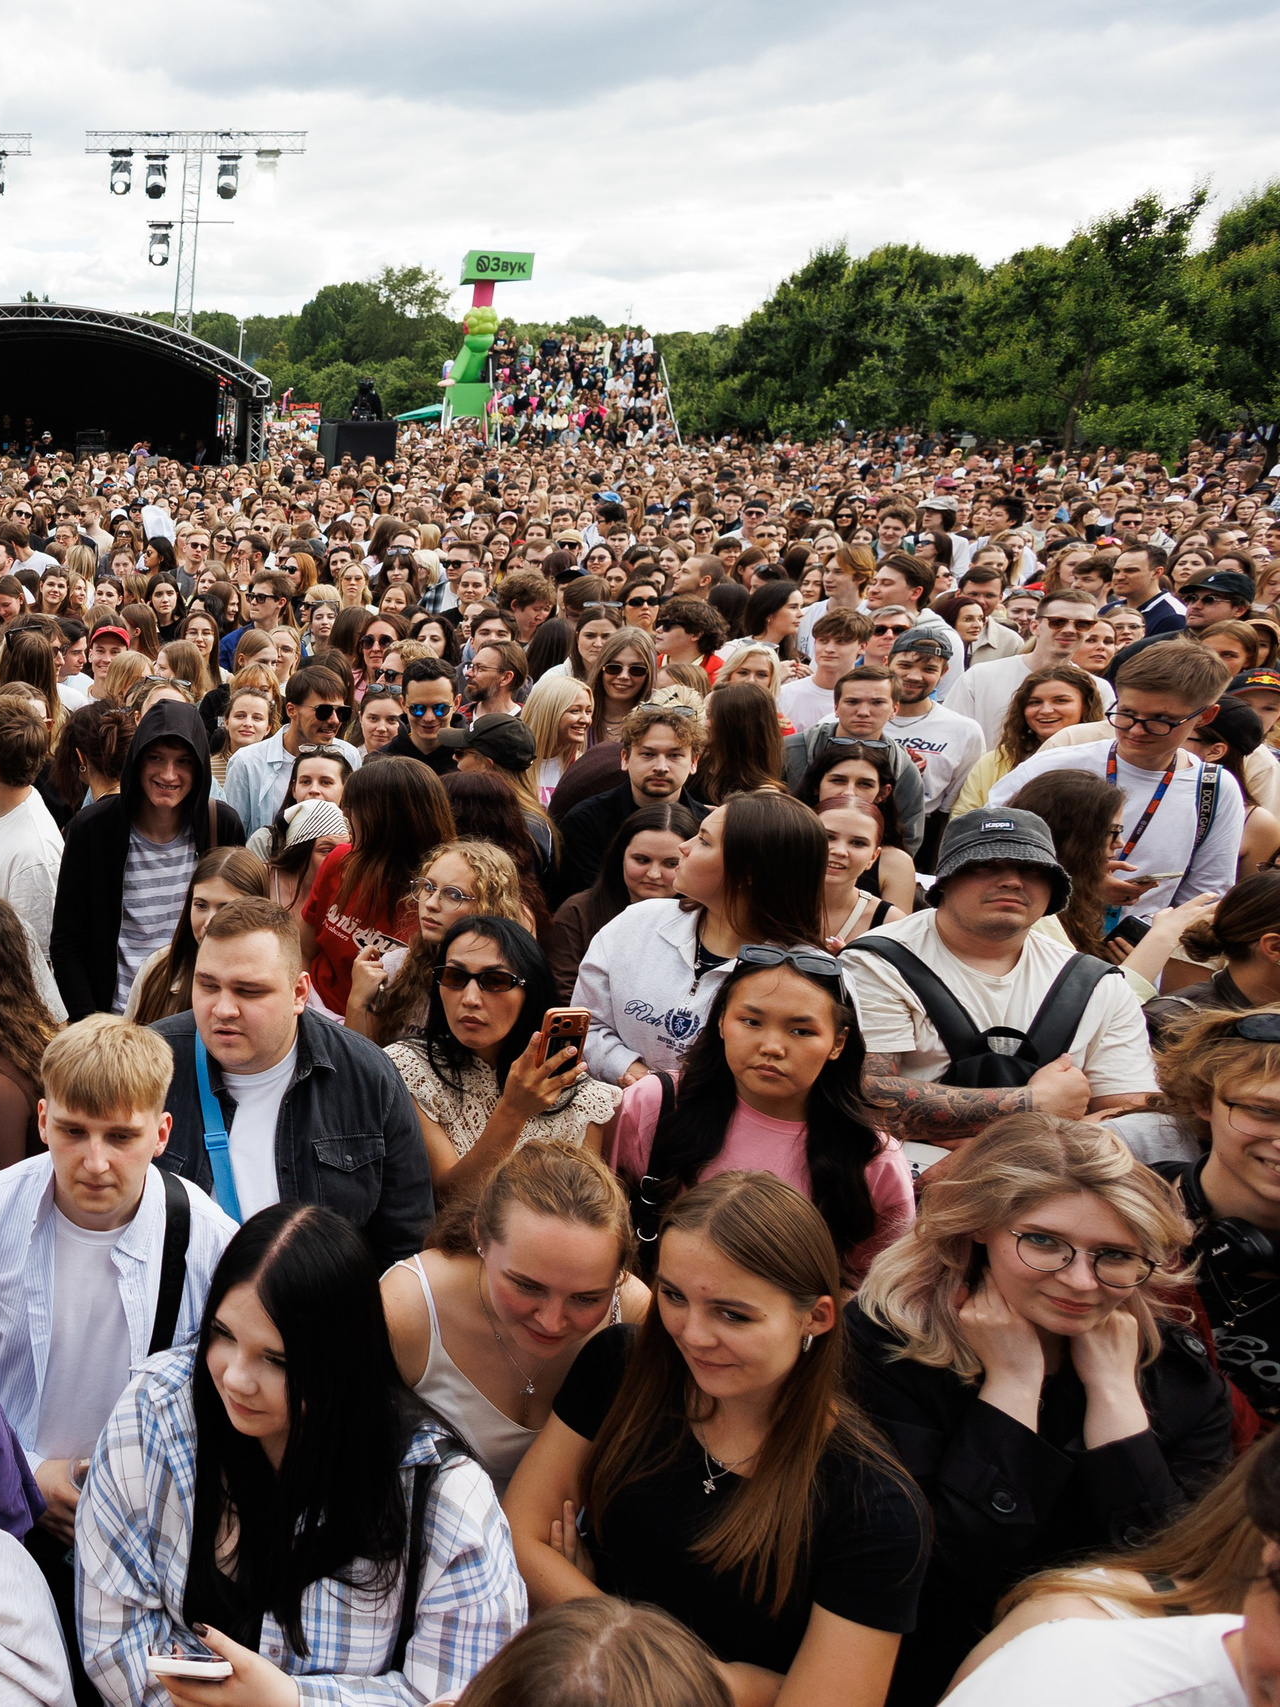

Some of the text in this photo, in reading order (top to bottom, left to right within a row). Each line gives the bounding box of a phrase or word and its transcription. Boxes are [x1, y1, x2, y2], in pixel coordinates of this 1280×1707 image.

[490, 256, 527, 276] Звук
[624, 1000, 665, 1027] Rich
[657, 1035, 676, 1047] ROYAL
